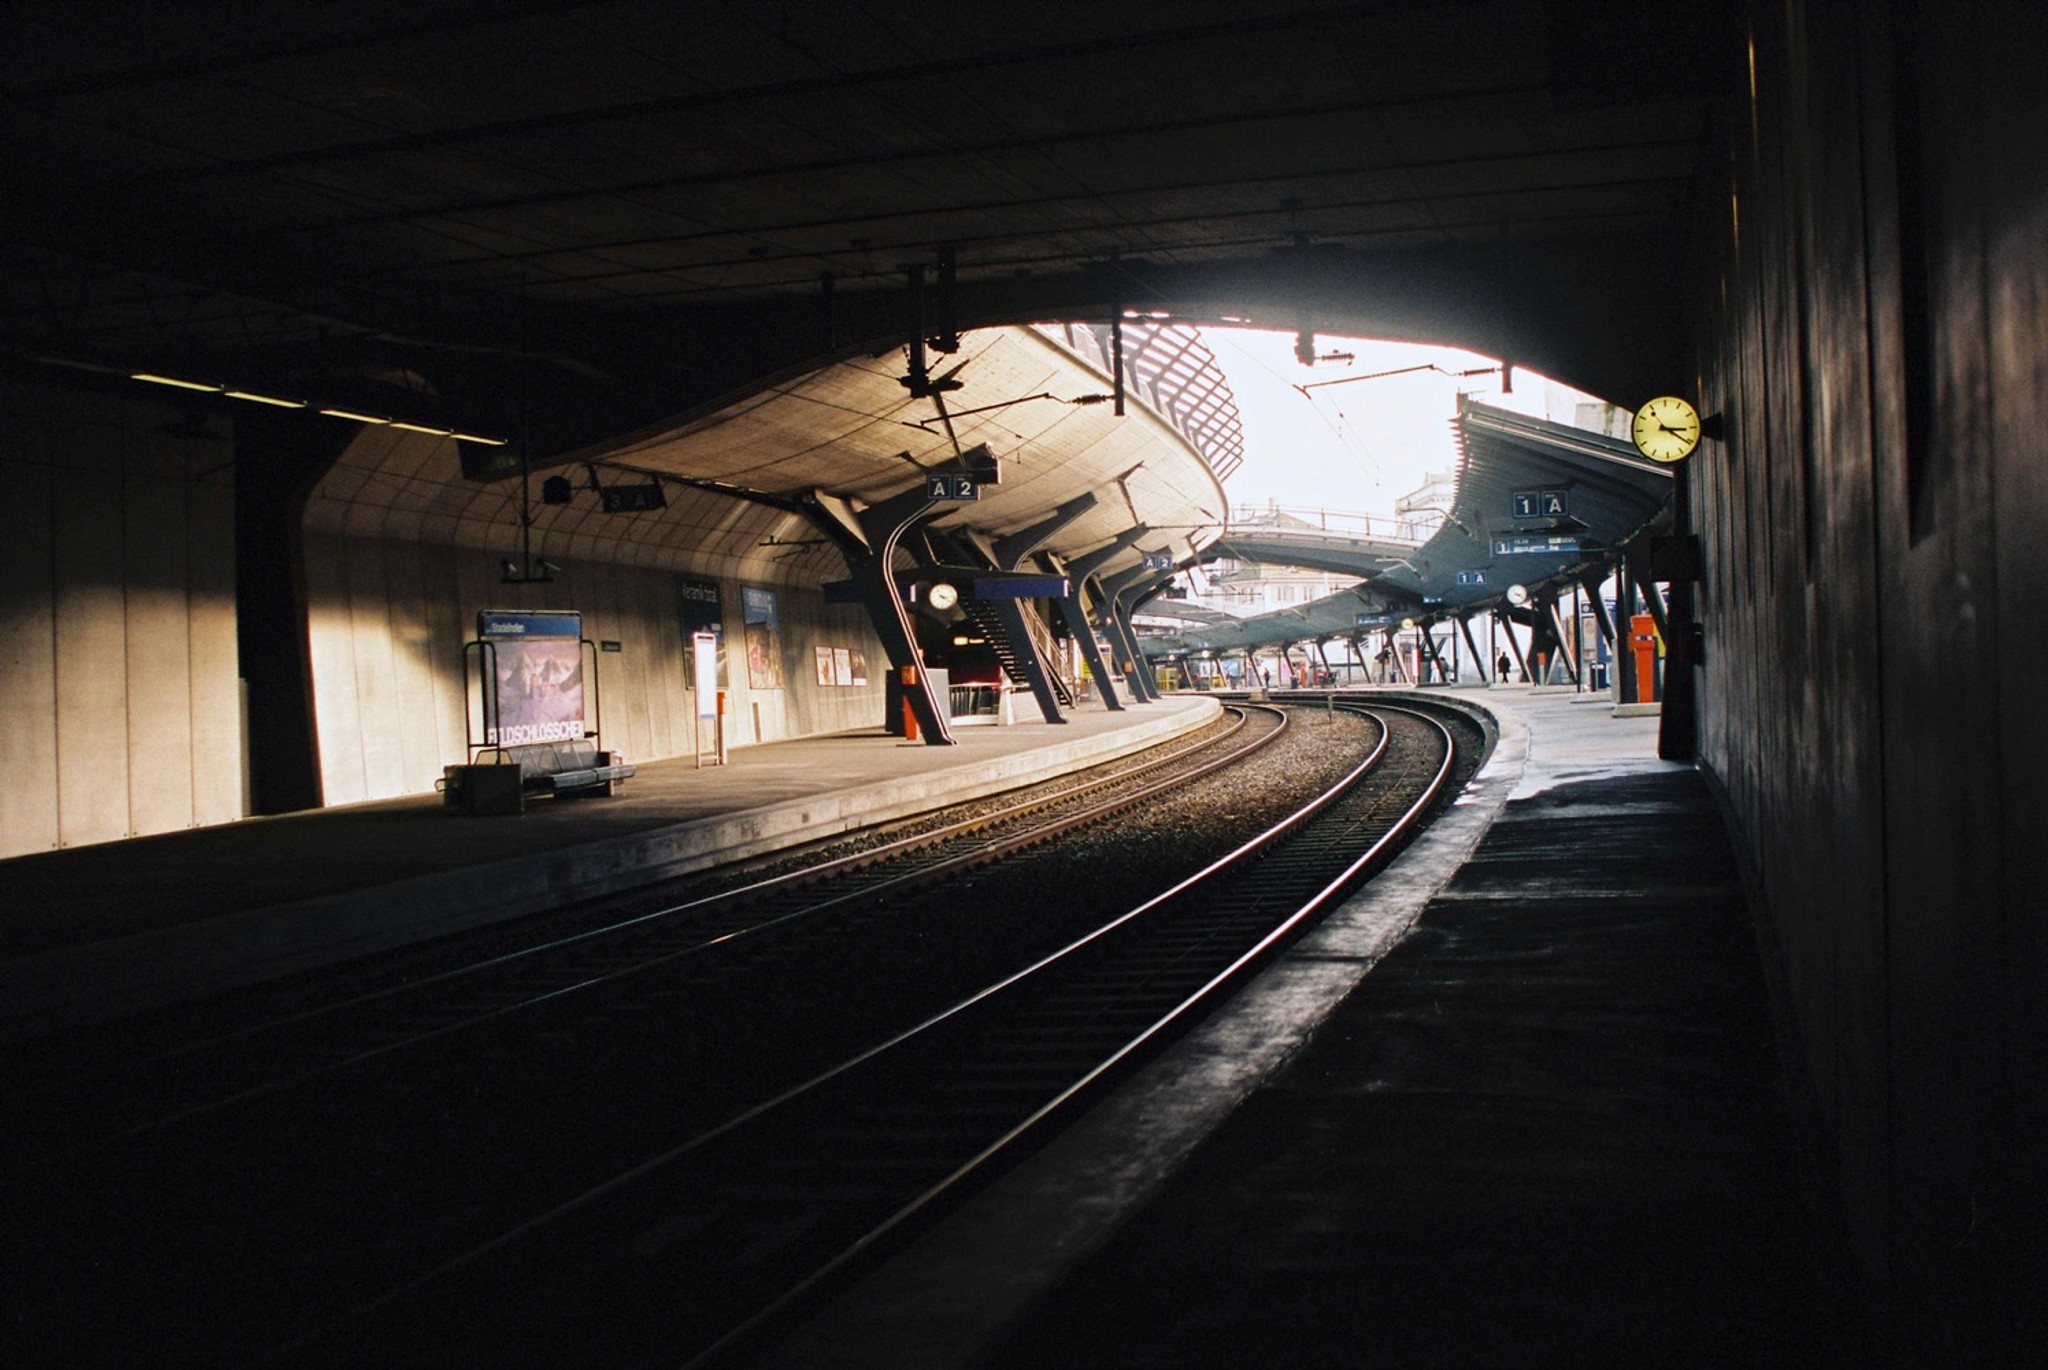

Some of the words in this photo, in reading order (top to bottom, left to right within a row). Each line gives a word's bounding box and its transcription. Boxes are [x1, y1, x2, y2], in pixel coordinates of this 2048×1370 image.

[933, 482, 945, 496] A
[960, 481, 971, 496] 2
[1522, 499, 1529, 514] 1
[1549, 498, 1562, 513] A
[1476, 574, 1484, 583] A
